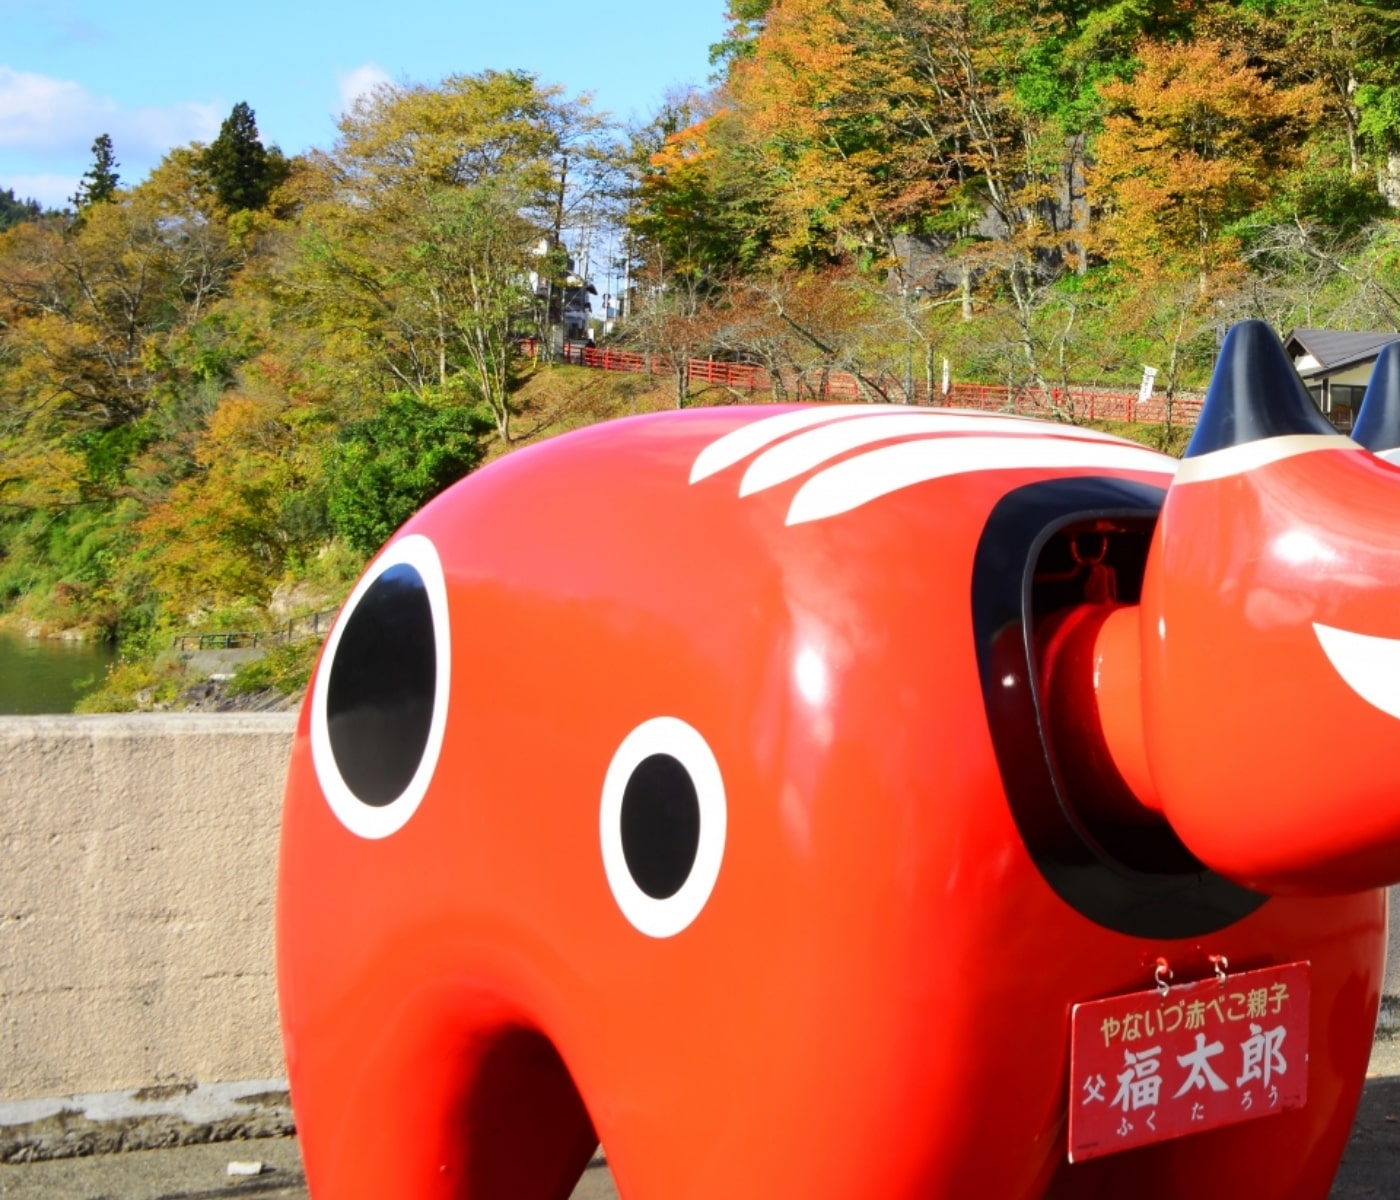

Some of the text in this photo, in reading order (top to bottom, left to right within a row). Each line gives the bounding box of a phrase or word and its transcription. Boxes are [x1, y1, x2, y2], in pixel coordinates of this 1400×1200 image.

[1100, 982, 1289, 1047] やないづ赤べこ親子
[1082, 1023, 1288, 1113] 父 福太郎
